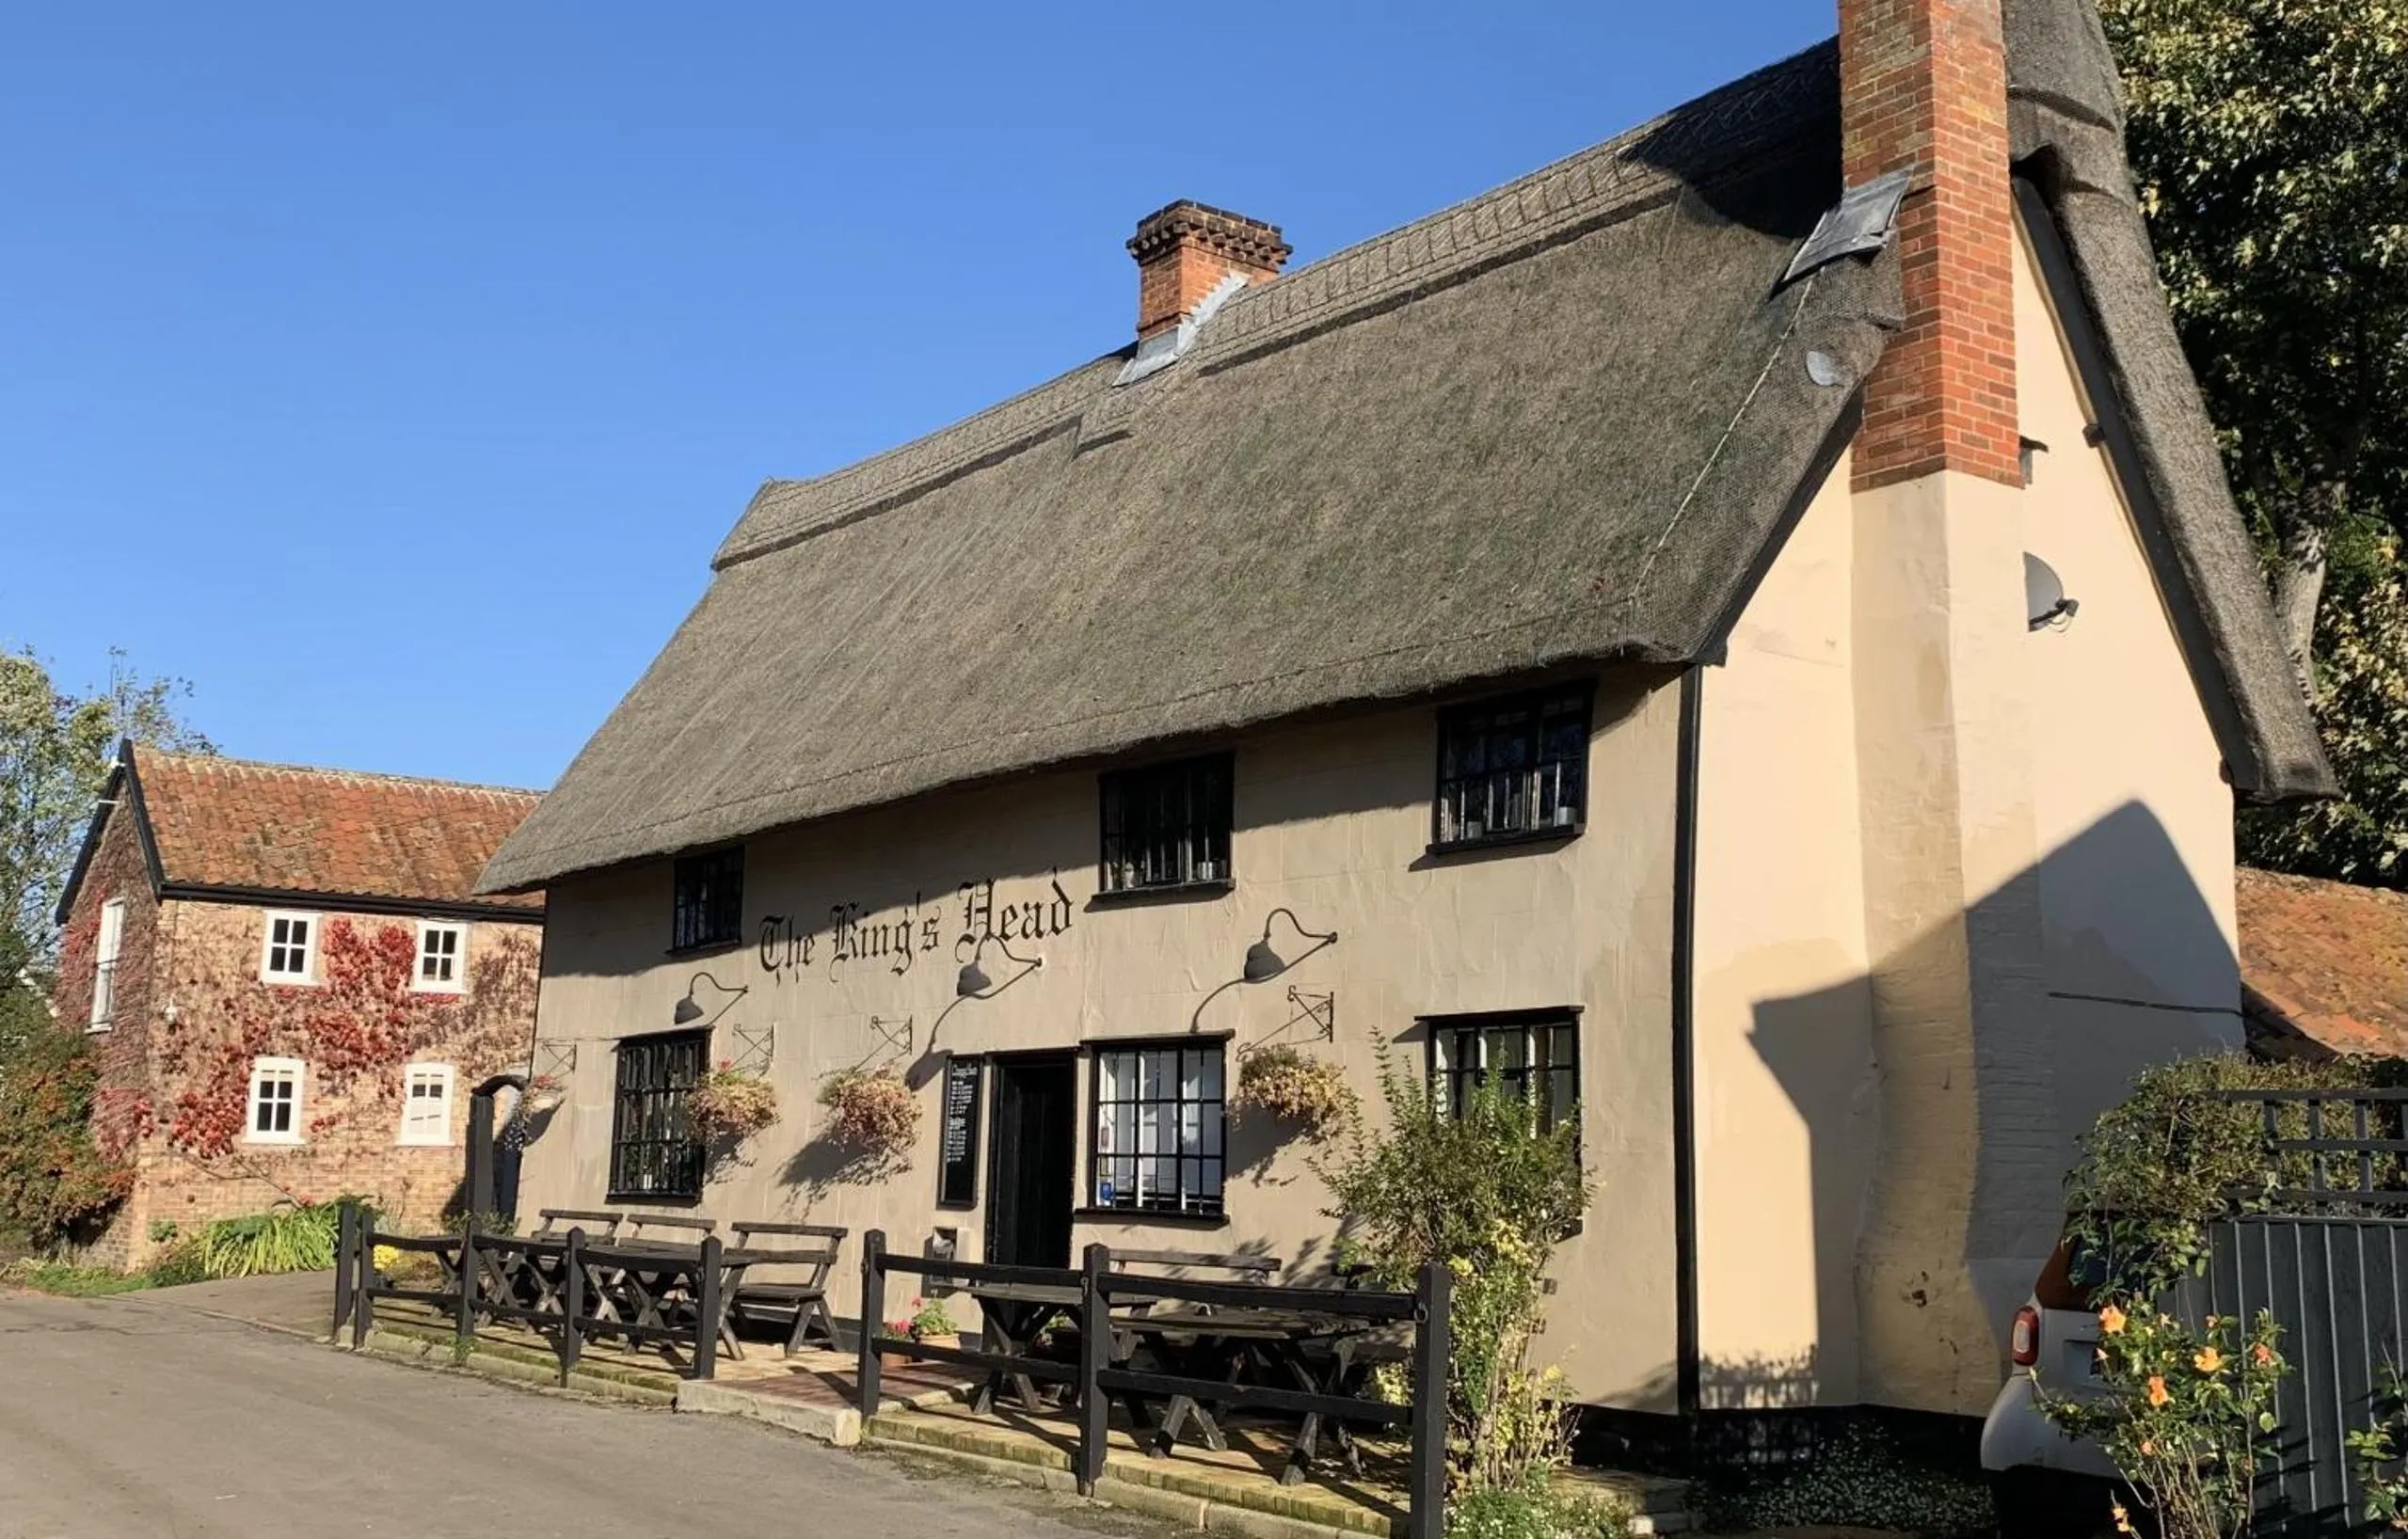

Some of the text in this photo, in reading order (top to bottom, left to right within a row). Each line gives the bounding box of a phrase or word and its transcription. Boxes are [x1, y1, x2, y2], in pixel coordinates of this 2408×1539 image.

[759, 865, 1074, 987] The King's Head
